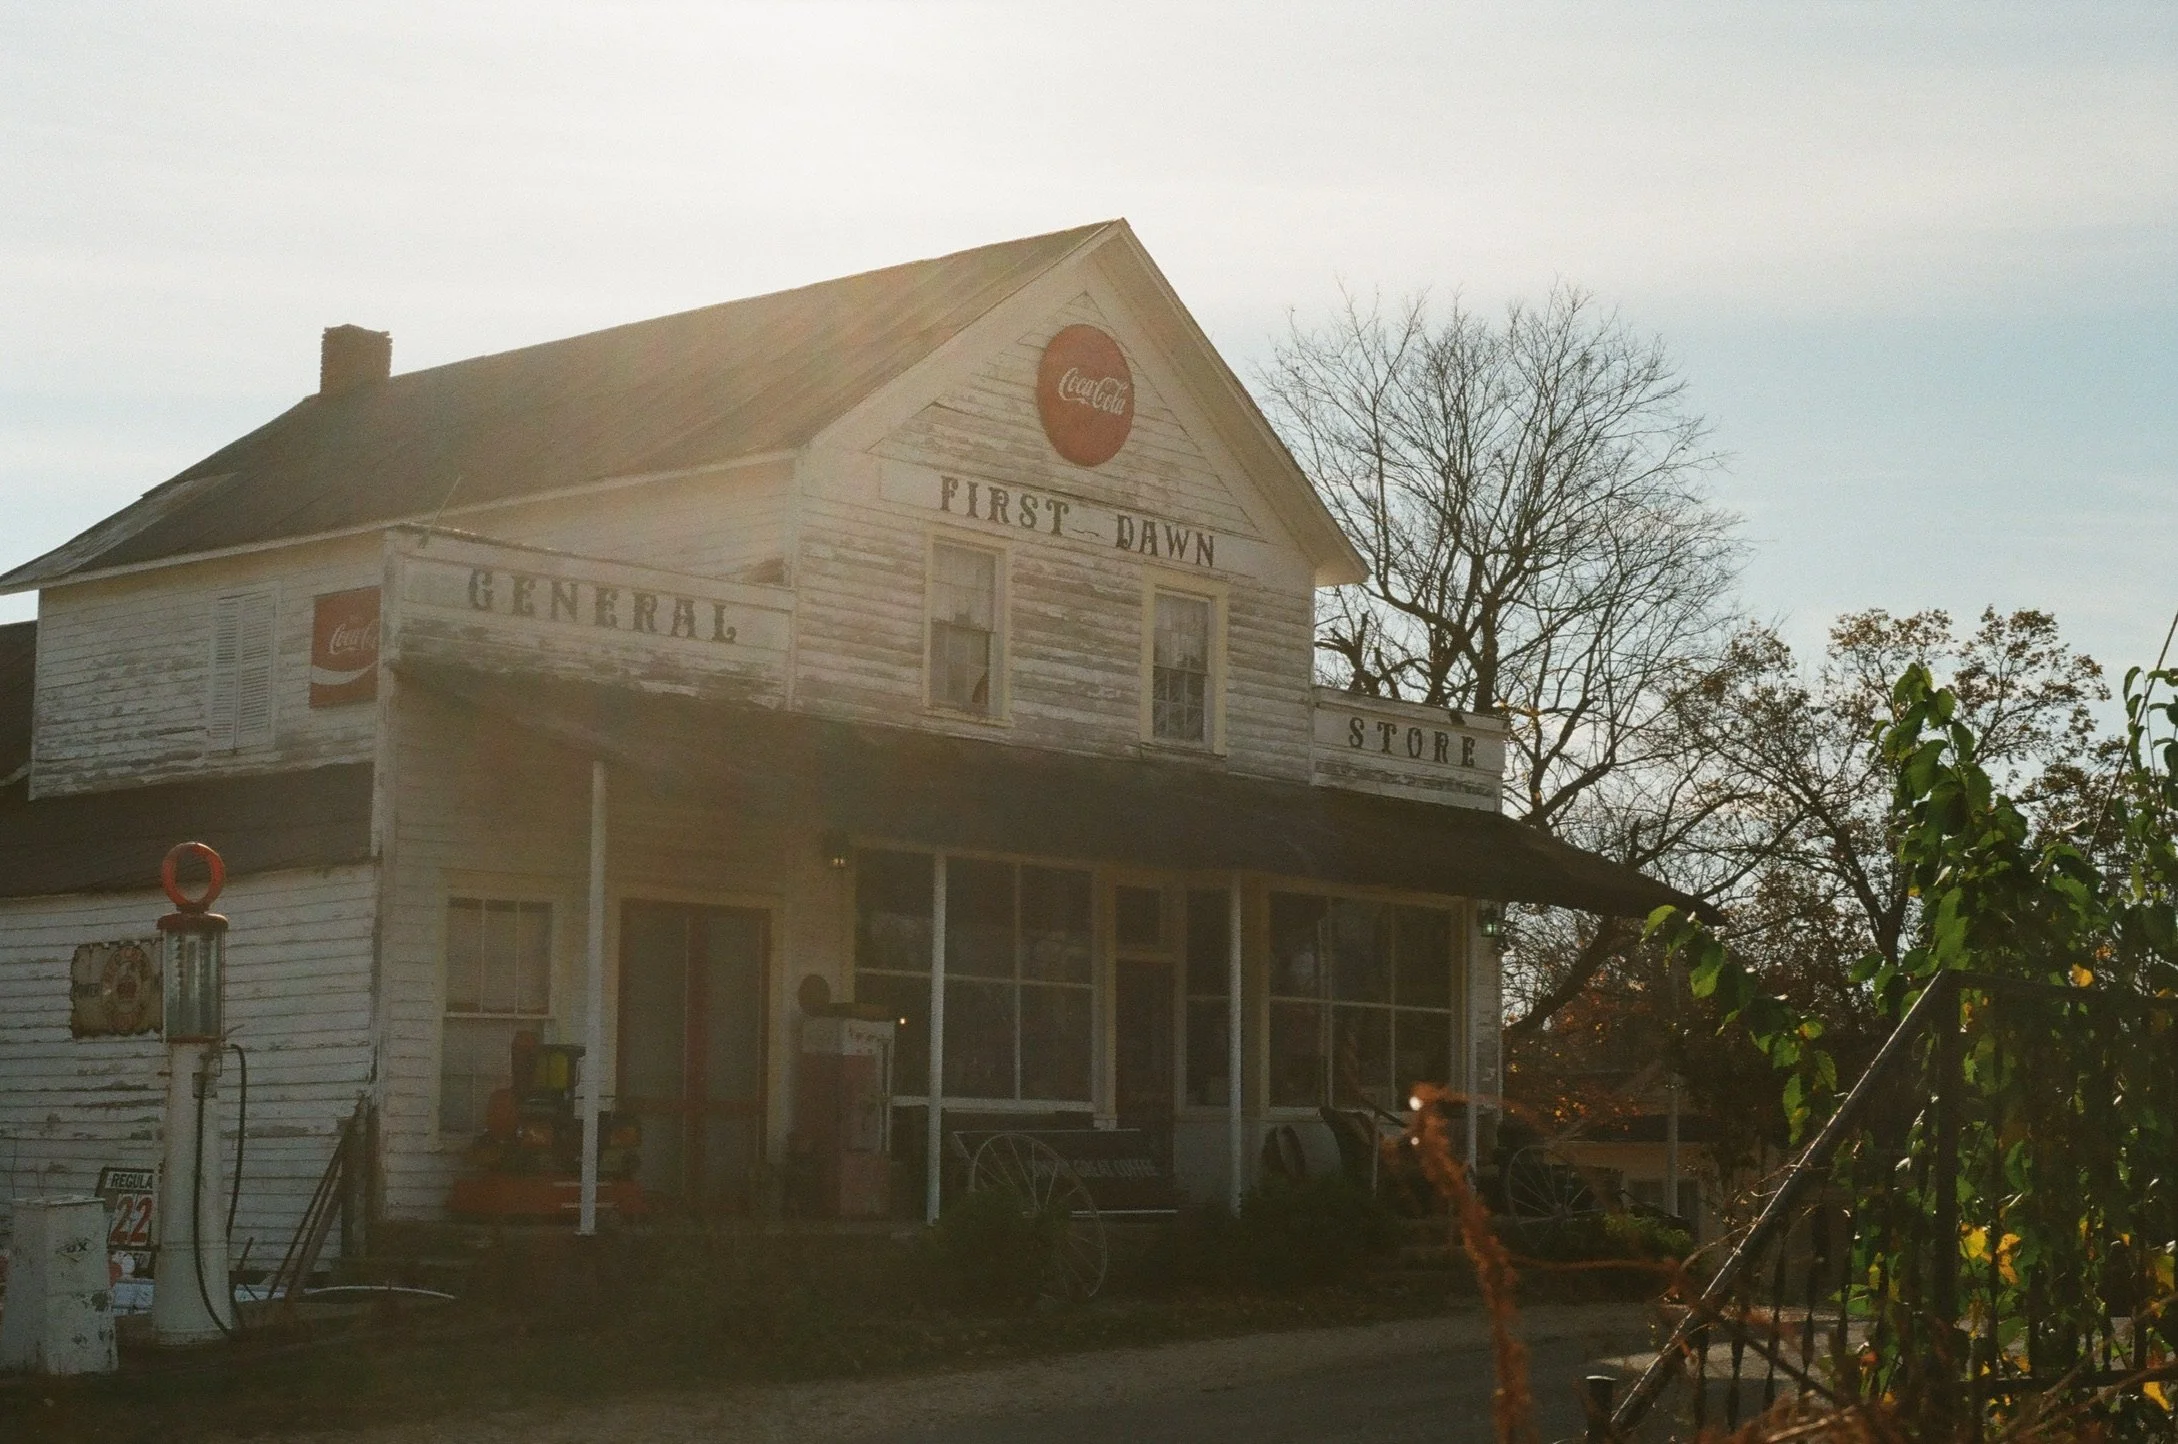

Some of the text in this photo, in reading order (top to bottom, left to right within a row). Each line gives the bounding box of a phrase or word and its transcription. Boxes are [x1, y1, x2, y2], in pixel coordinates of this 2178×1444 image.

[939, 475, 1214, 568] FIRST DAWN
[467, 567, 737, 644] GENERAL
[1349, 716, 1476, 768] STORE
[111, 1173, 153, 1190] REGULA
[111, 1195, 153, 1242] 22
